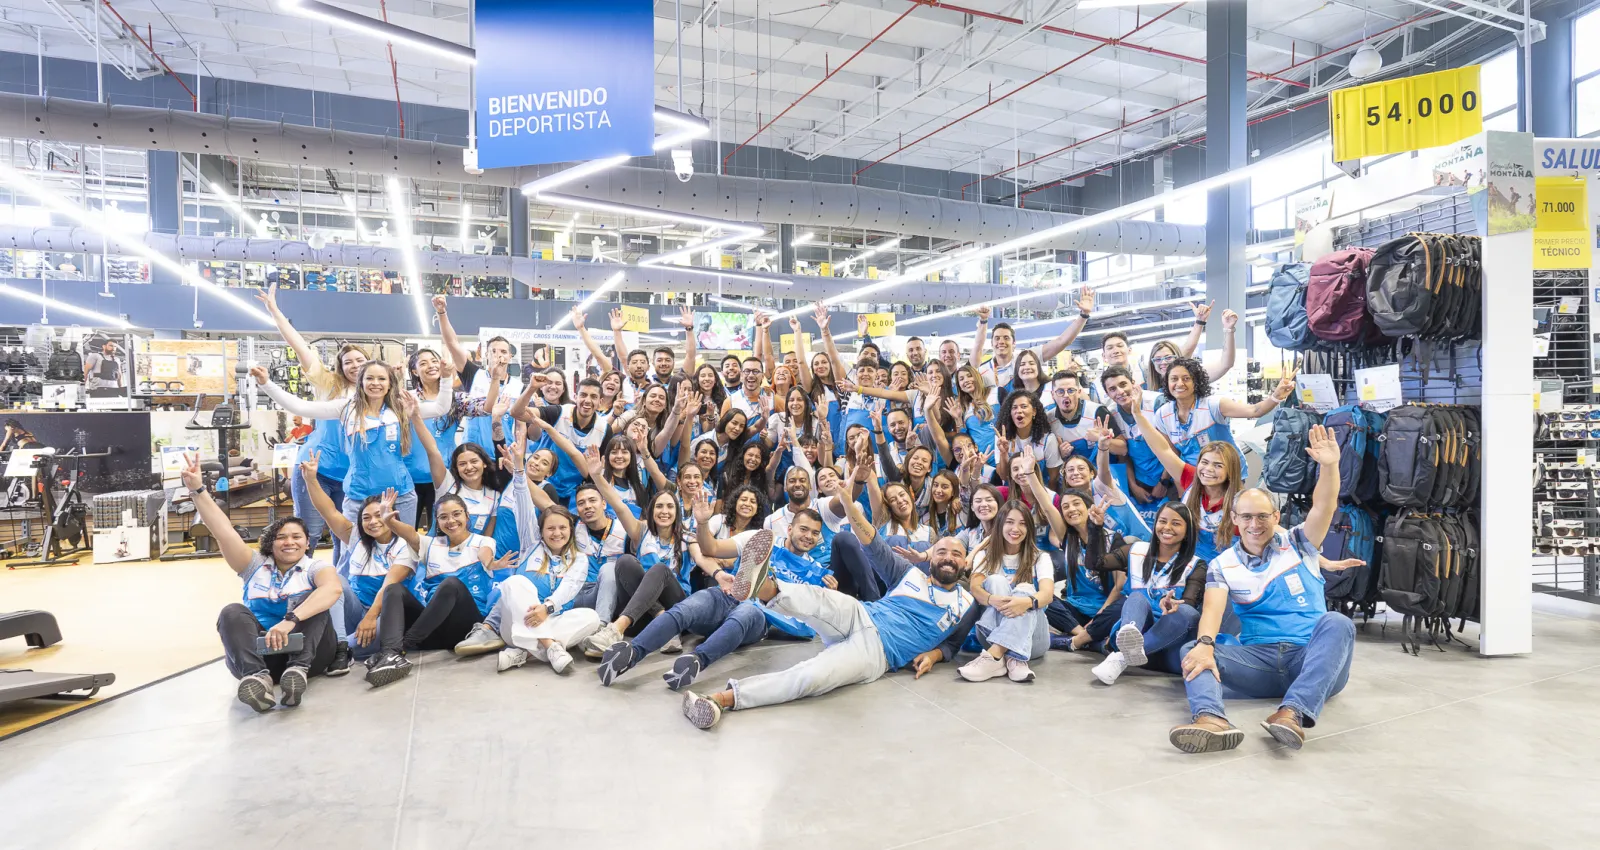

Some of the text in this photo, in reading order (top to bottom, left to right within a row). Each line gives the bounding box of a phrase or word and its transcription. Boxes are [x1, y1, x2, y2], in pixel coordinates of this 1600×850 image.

[488, 87, 608, 116] BIENVENIDO
[1366, 91, 1477, 127] 54,000
[489, 110, 612, 138] DEPORTISTA
[1541, 246, 1580, 257] TÉCNICO
